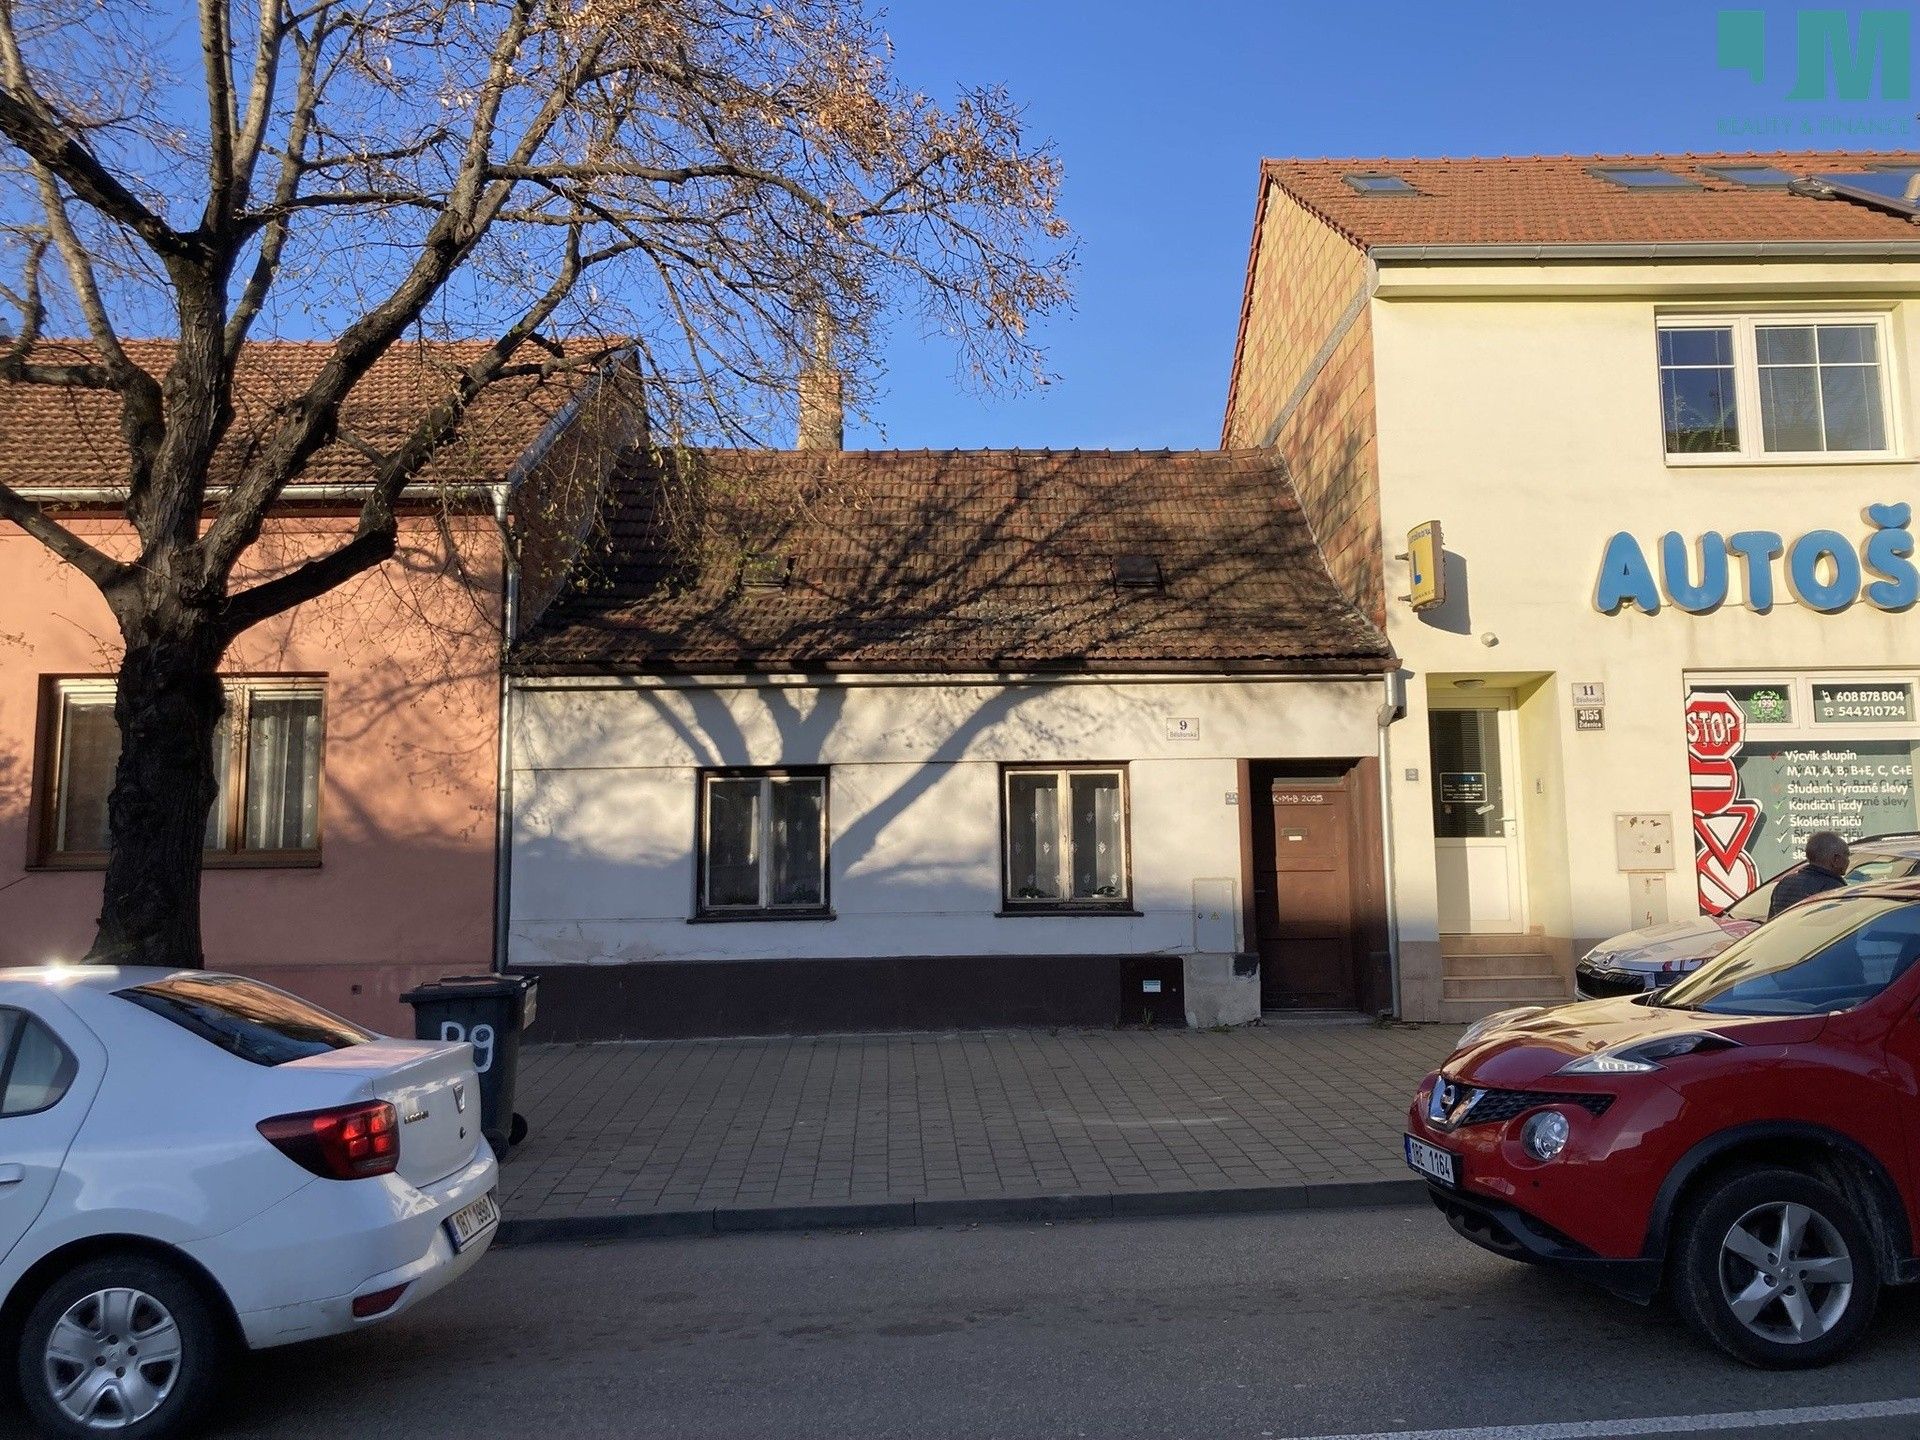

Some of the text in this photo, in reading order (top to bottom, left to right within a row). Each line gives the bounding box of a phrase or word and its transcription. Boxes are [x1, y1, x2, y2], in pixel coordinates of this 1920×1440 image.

[1594, 502, 1920, 613] AUTOŠ
[1583, 685, 1594, 696] 11
[1580, 710, 1600, 720] 3155
[1180, 720, 1187, 730] 9
[1687, 711, 1736, 743] STOP
[1784, 750, 1857, 763] Výcvik skupin
[1851, 766, 1875, 777] B+E,
[1891, 765, 1912, 775] C+E
[1787, 783, 1908, 796] Studenti výrazné slevy
[1788, 799, 1836, 811] Kondiční
[1790, 814, 1829, 827] Školení
[1429, 1149, 1451, 1178] 1164
